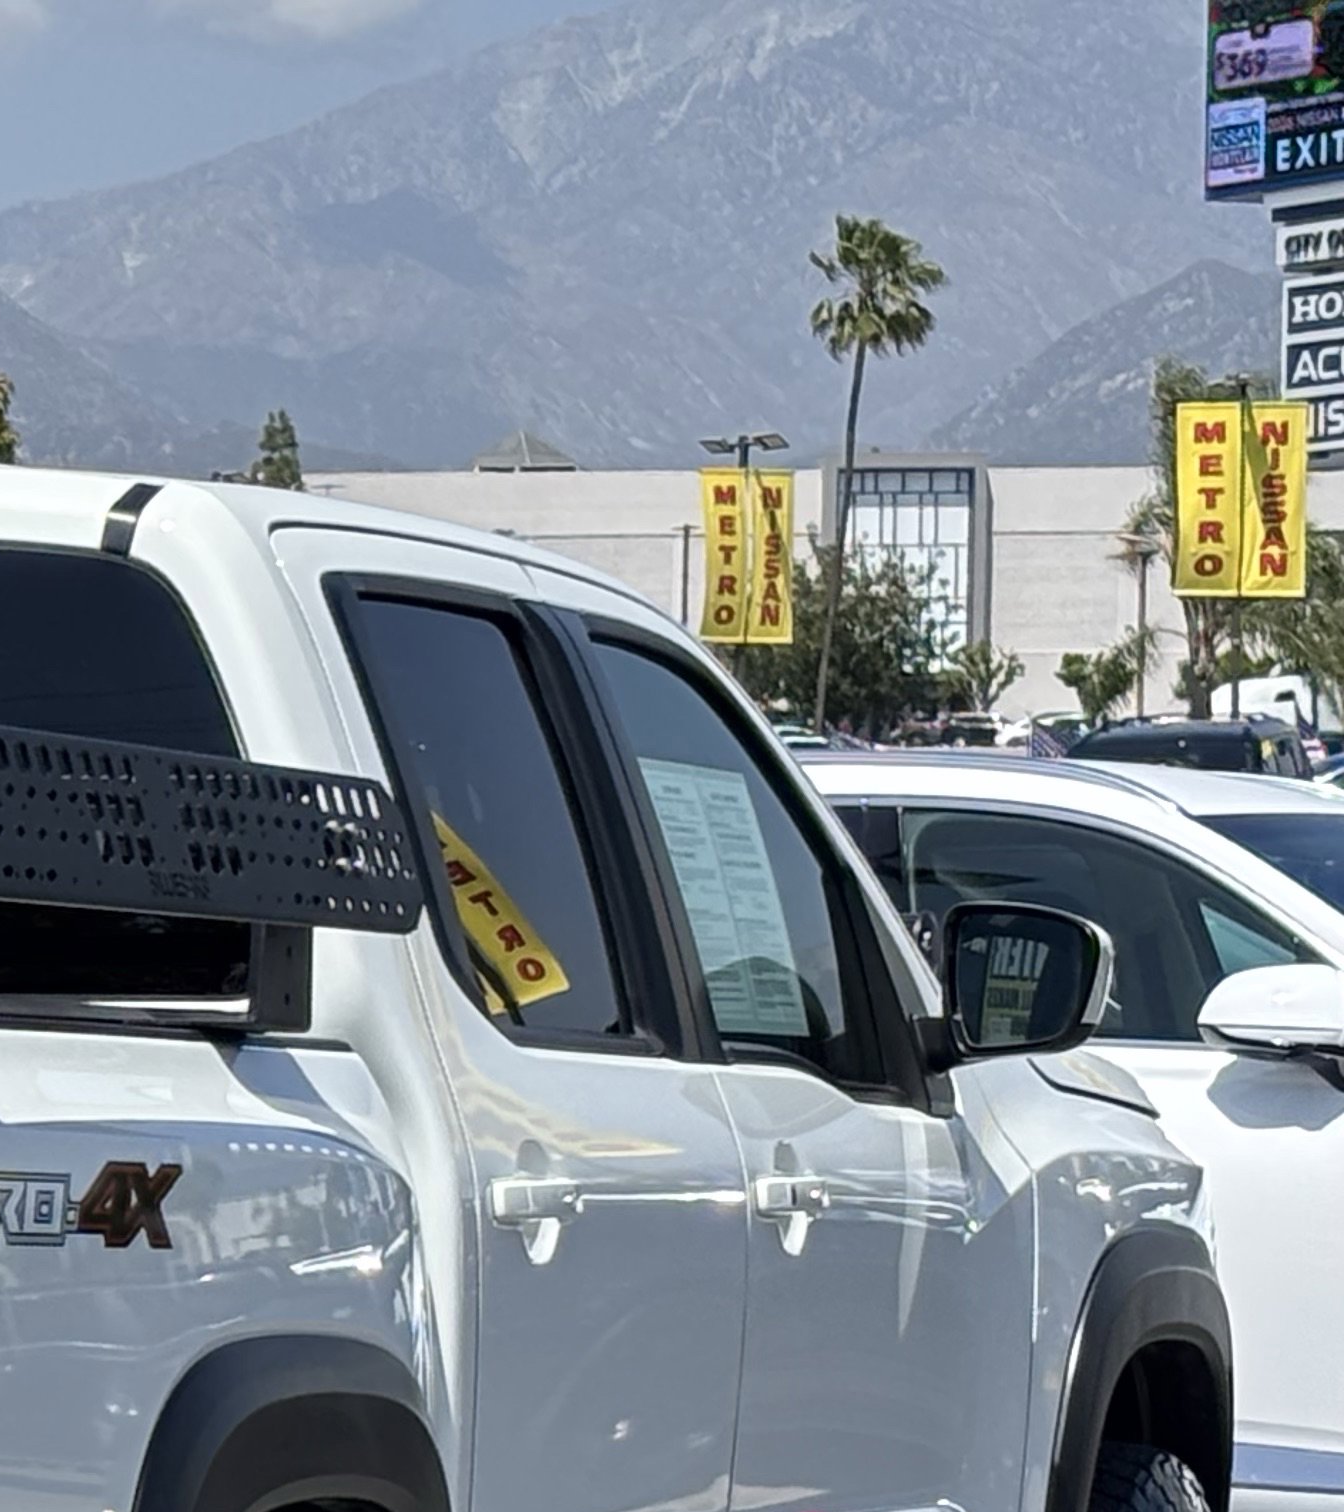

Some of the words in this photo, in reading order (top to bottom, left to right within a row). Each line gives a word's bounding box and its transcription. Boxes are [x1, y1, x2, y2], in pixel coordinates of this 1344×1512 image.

[1277, 129, 1344, 172] EXIT
[1291, 291, 1344, 323] HO
[1291, 345, 1344, 384] AC
[713, 484, 739, 626] METRO
[758, 485, 783, 627] NISSAN
[1193, 420, 1227, 577] METRO
[1259, 420, 1289, 577] NISSAN
